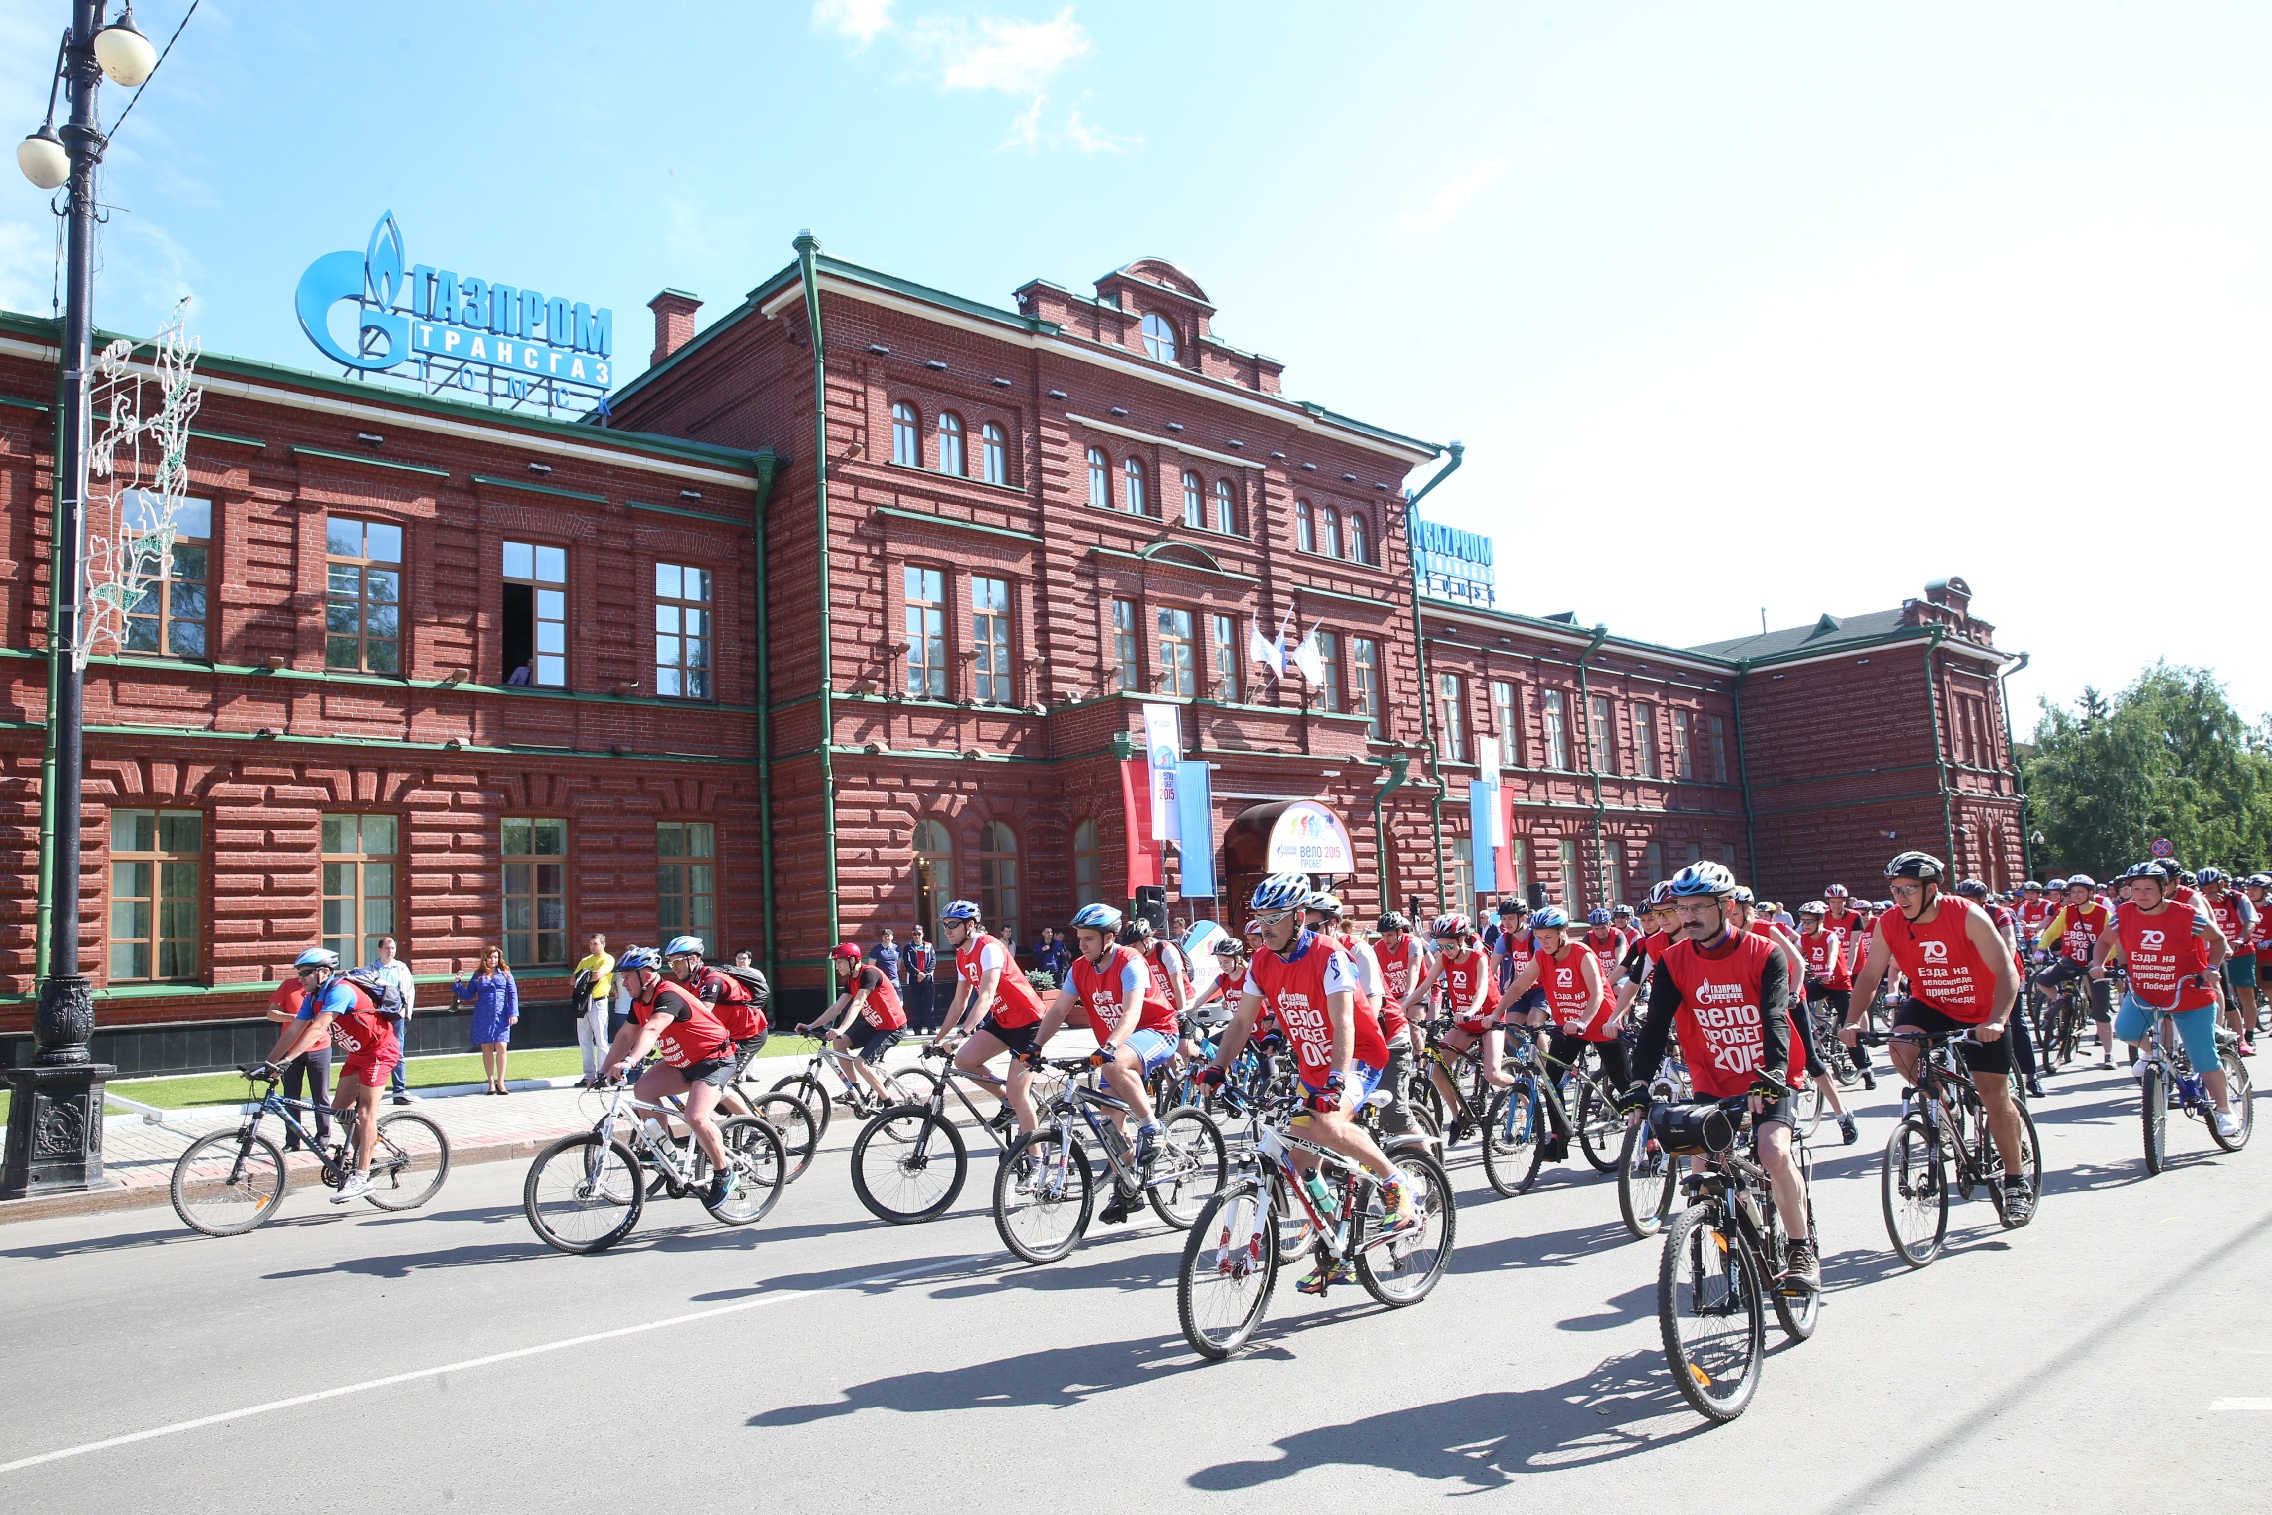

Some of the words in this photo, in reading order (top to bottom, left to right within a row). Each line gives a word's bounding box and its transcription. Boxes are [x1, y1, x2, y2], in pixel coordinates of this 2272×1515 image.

[413, 264, 612, 359] ГАЗПРОМ
[419, 324, 609, 385] ТРАНСГАЗ
[414, 357, 612, 416] ТОМСК
[1420, 520, 1493, 567] GAZPROM
[1427, 555, 1494, 583] TRANSGAZ
[1427, 576, 1496, 602] TOMSK
[2141, 929, 2165, 944] 70
[1919, 940, 1948, 957] 70
[2131, 951, 2157, 963] Езда
[2162, 955, 2176, 963] на
[964, 962, 978, 976] 70
[1555, 967, 1573, 982] 70
[1918, 967, 1948, 977] Езда
[1953, 966, 1969, 975] на
[2132, 964, 2176, 972] велосипеде
[1452, 970, 1467, 983] 70
[1922, 977, 1973, 986] велосипеде
[2133, 972, 2176, 981] приведет
[1710, 983, 1743, 994] ГАЗПРОМ
[1926, 984, 1975, 998] приведет
[2143, 982, 2176, 991] Победе!
[1553, 990, 1572, 1000] Езда
[1575, 991, 1586, 1000] на
[1702, 1024, 1763, 1044] ПРОБЕГ
[616, 1204, 640, 1237] MAXXIS
